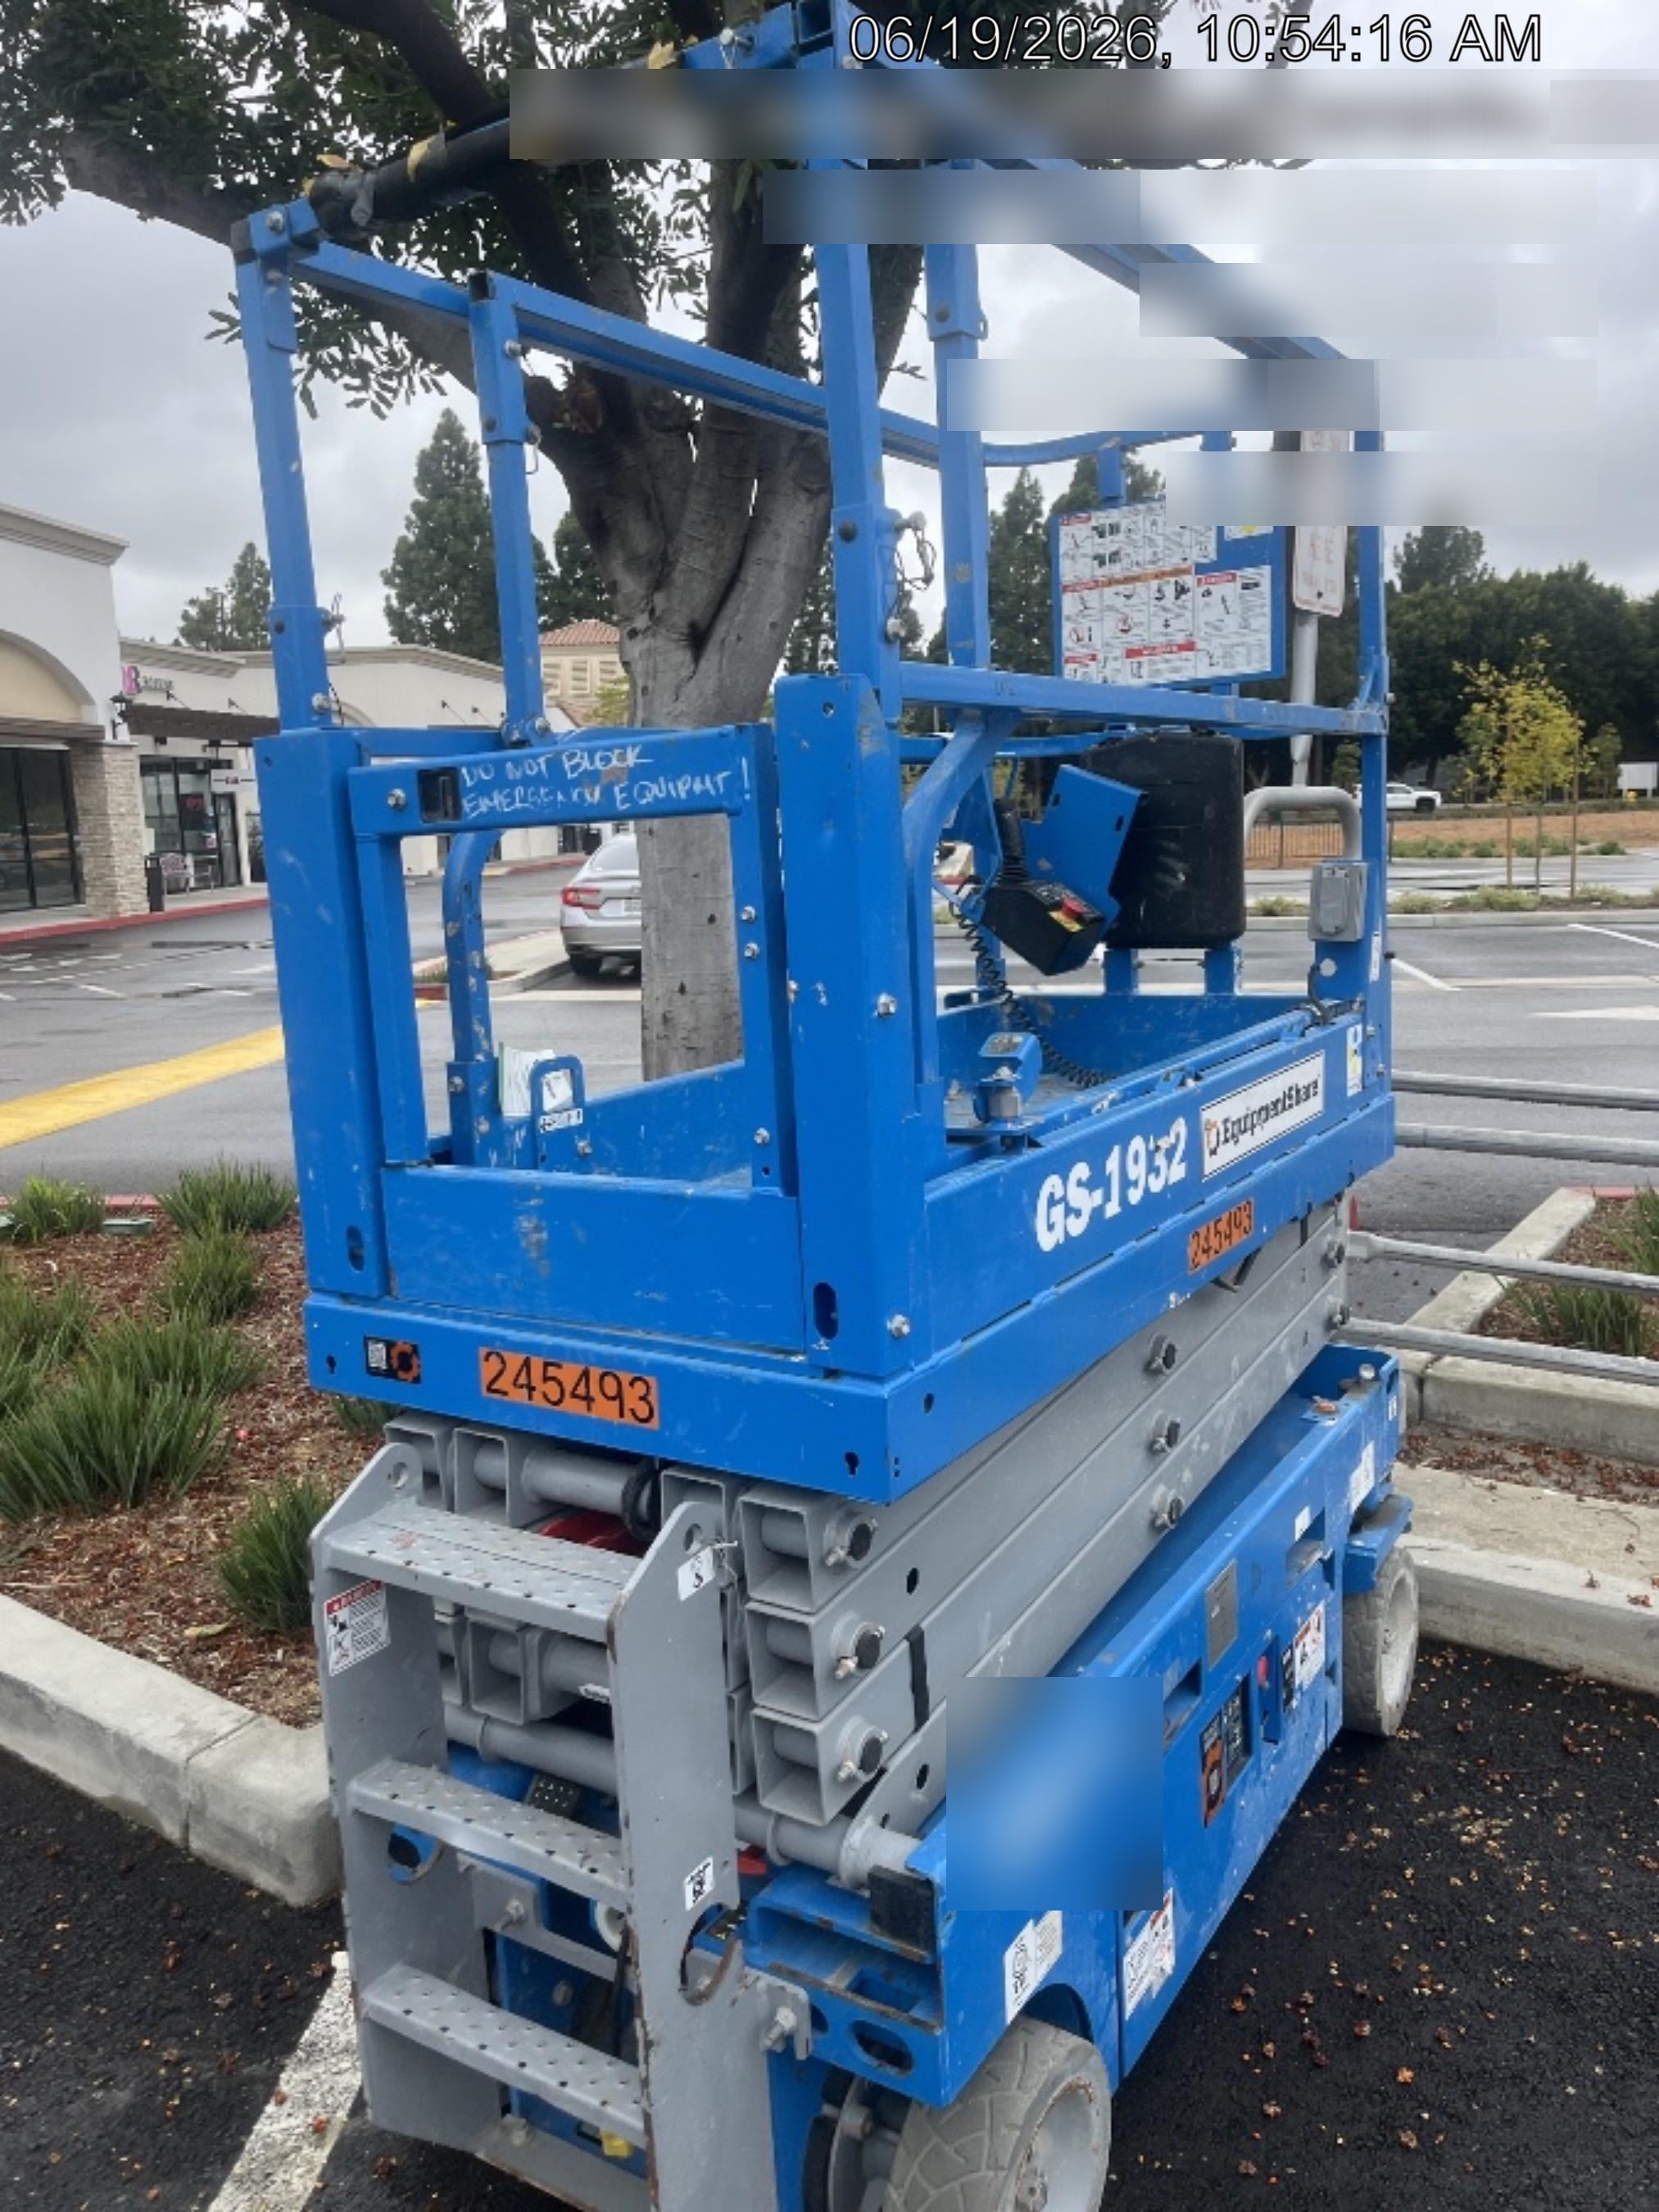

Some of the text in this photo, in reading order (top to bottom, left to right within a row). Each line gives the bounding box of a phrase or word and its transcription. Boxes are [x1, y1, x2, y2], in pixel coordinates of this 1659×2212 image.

[460, 744, 654, 787] DO NOT BLOCK
[1222, 1077, 1319, 1146] EquipmentShare
[1036, 1117, 1188, 1253] GS-1932
[1190, 1199, 1253, 1269] 245493
[483, 1350, 655, 1425] 245493
